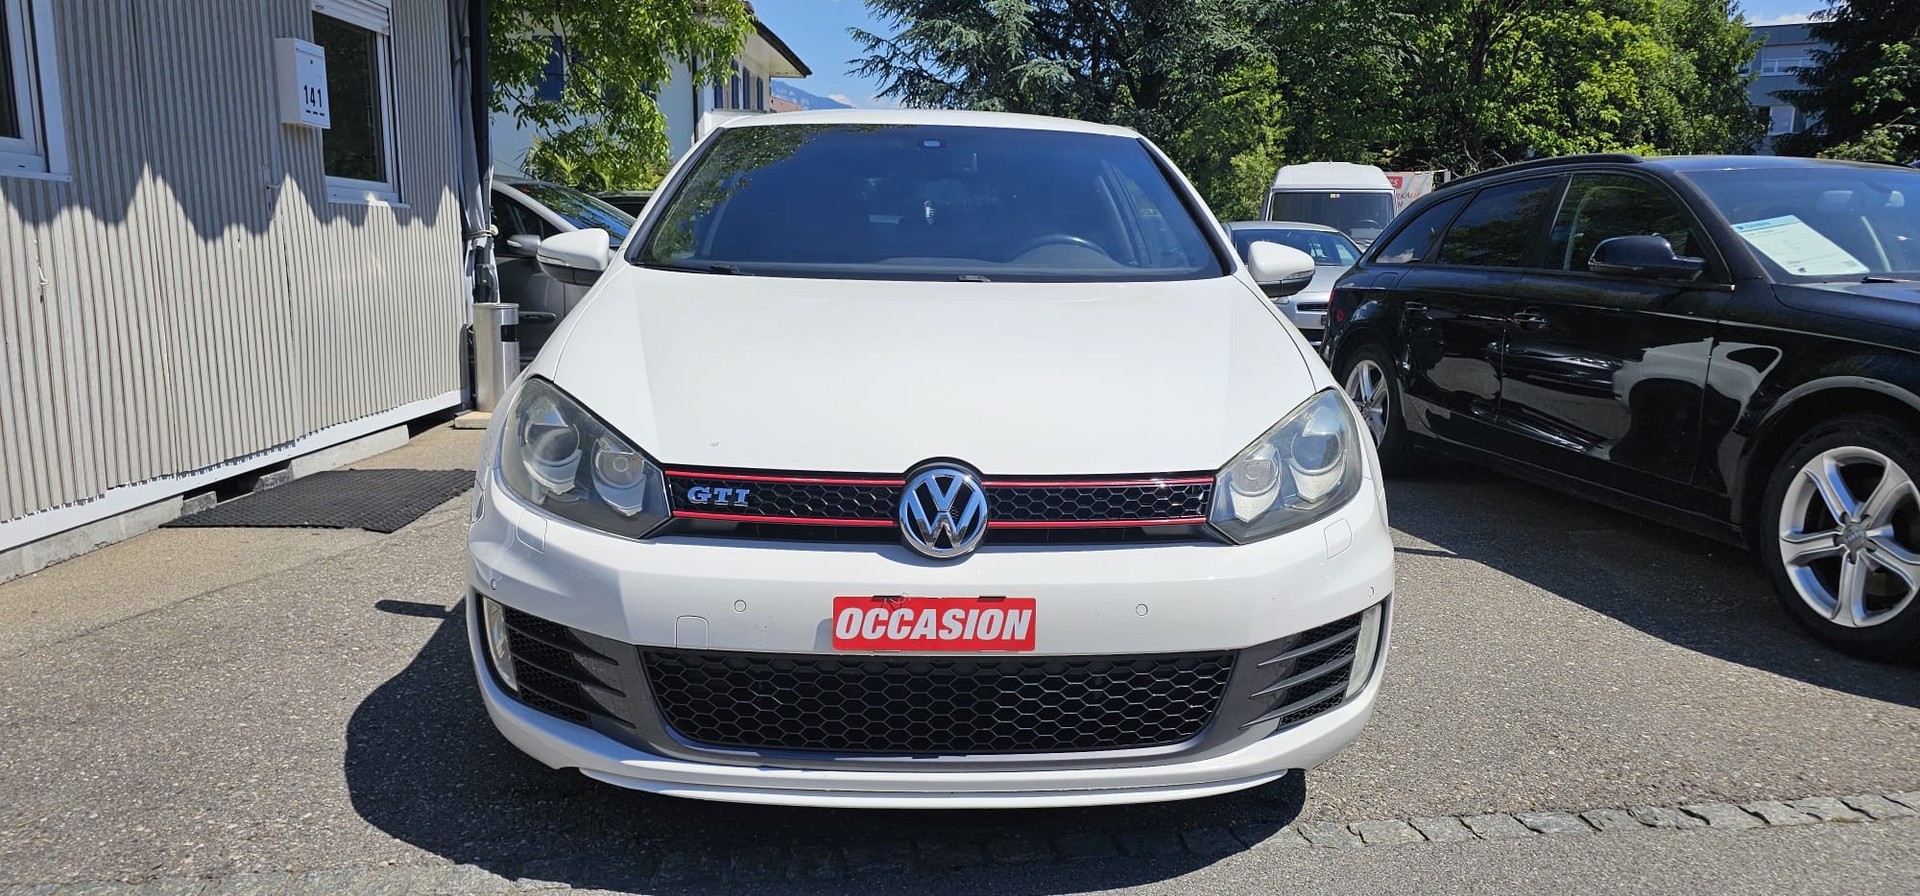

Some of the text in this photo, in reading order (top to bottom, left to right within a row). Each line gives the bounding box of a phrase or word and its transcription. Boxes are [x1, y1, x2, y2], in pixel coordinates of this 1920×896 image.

[304, 85, 322, 108] 141
[687, 485, 750, 507] GTI
[900, 469, 987, 557] VW
[835, 607, 1032, 640] OCCASION
